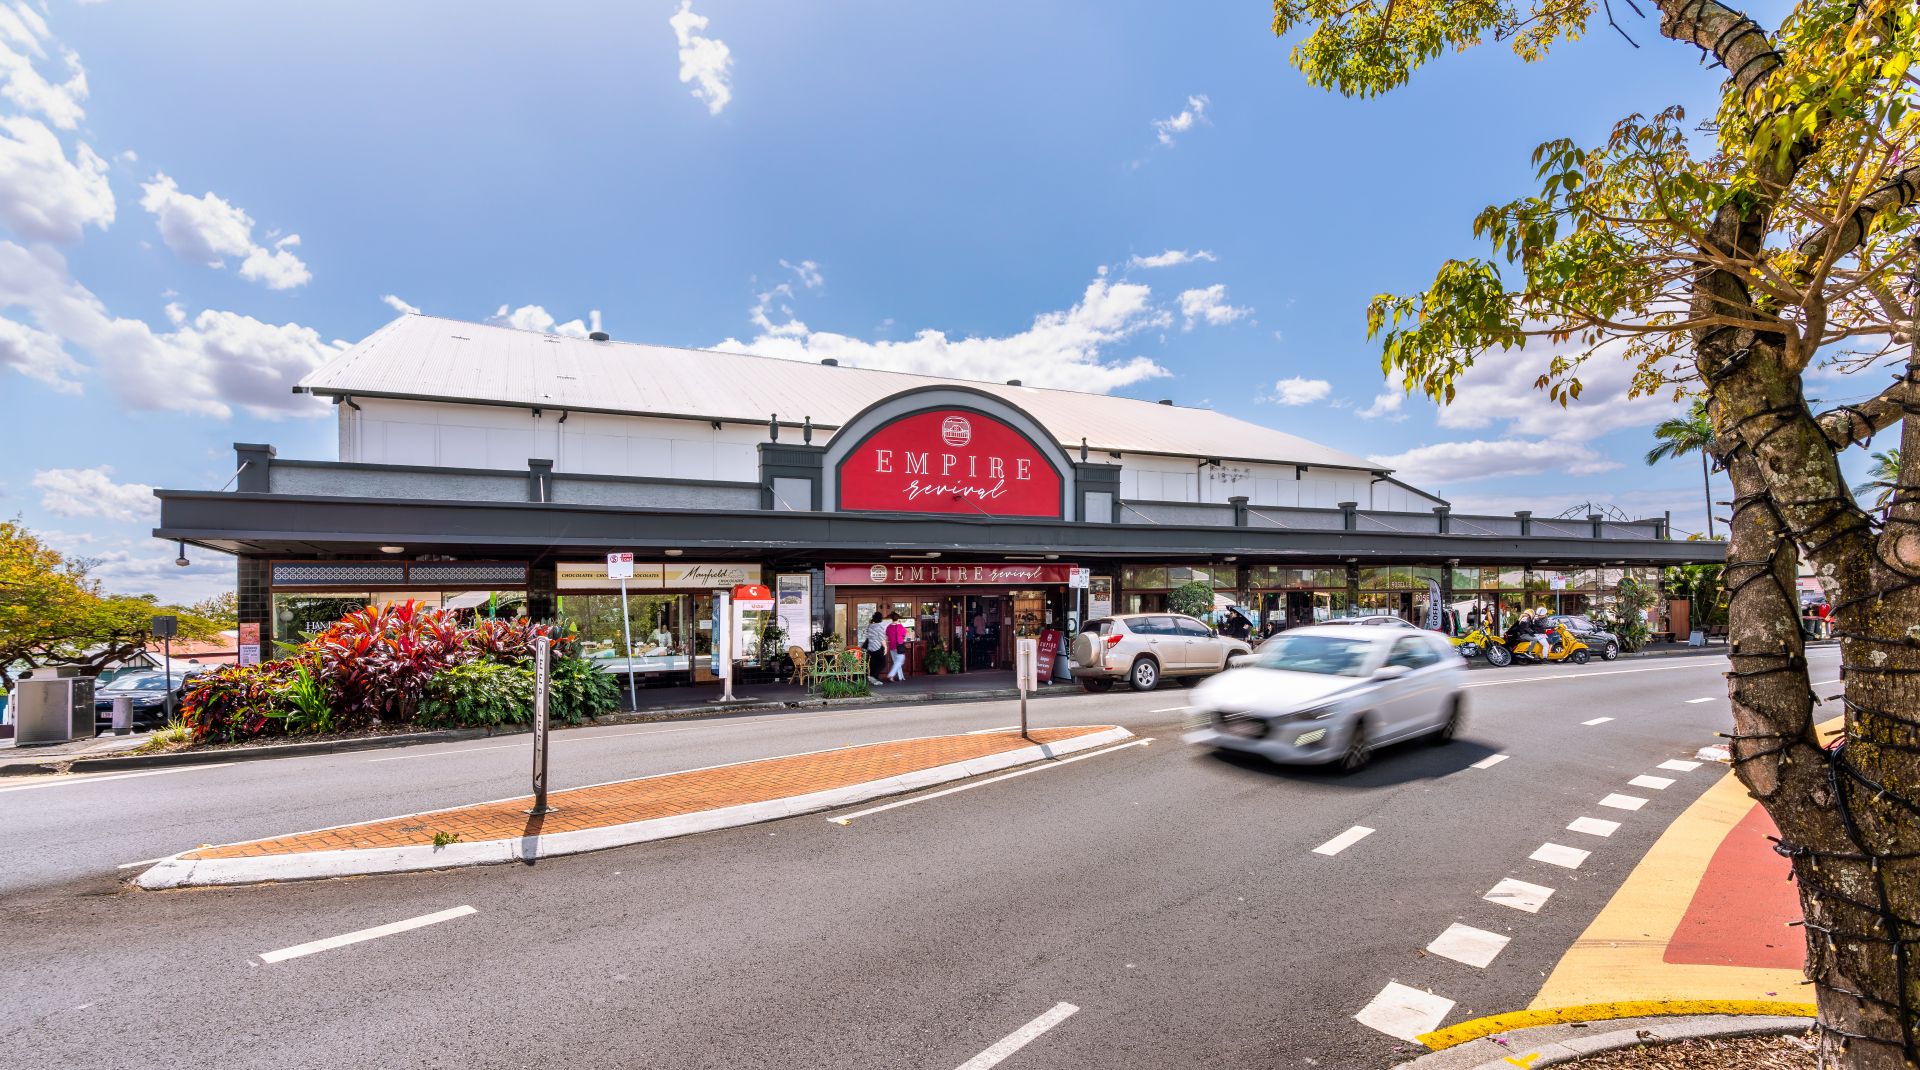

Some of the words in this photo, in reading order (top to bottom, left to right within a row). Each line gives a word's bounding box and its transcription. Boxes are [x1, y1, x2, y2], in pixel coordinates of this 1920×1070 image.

[875, 449, 1031, 480] EMPIRE
[903, 479, 1007, 500] revival
[682, 565, 728, 586] Mayfield
[894, 566, 983, 581] EMPIRE
[988, 565, 1042, 582] revival
